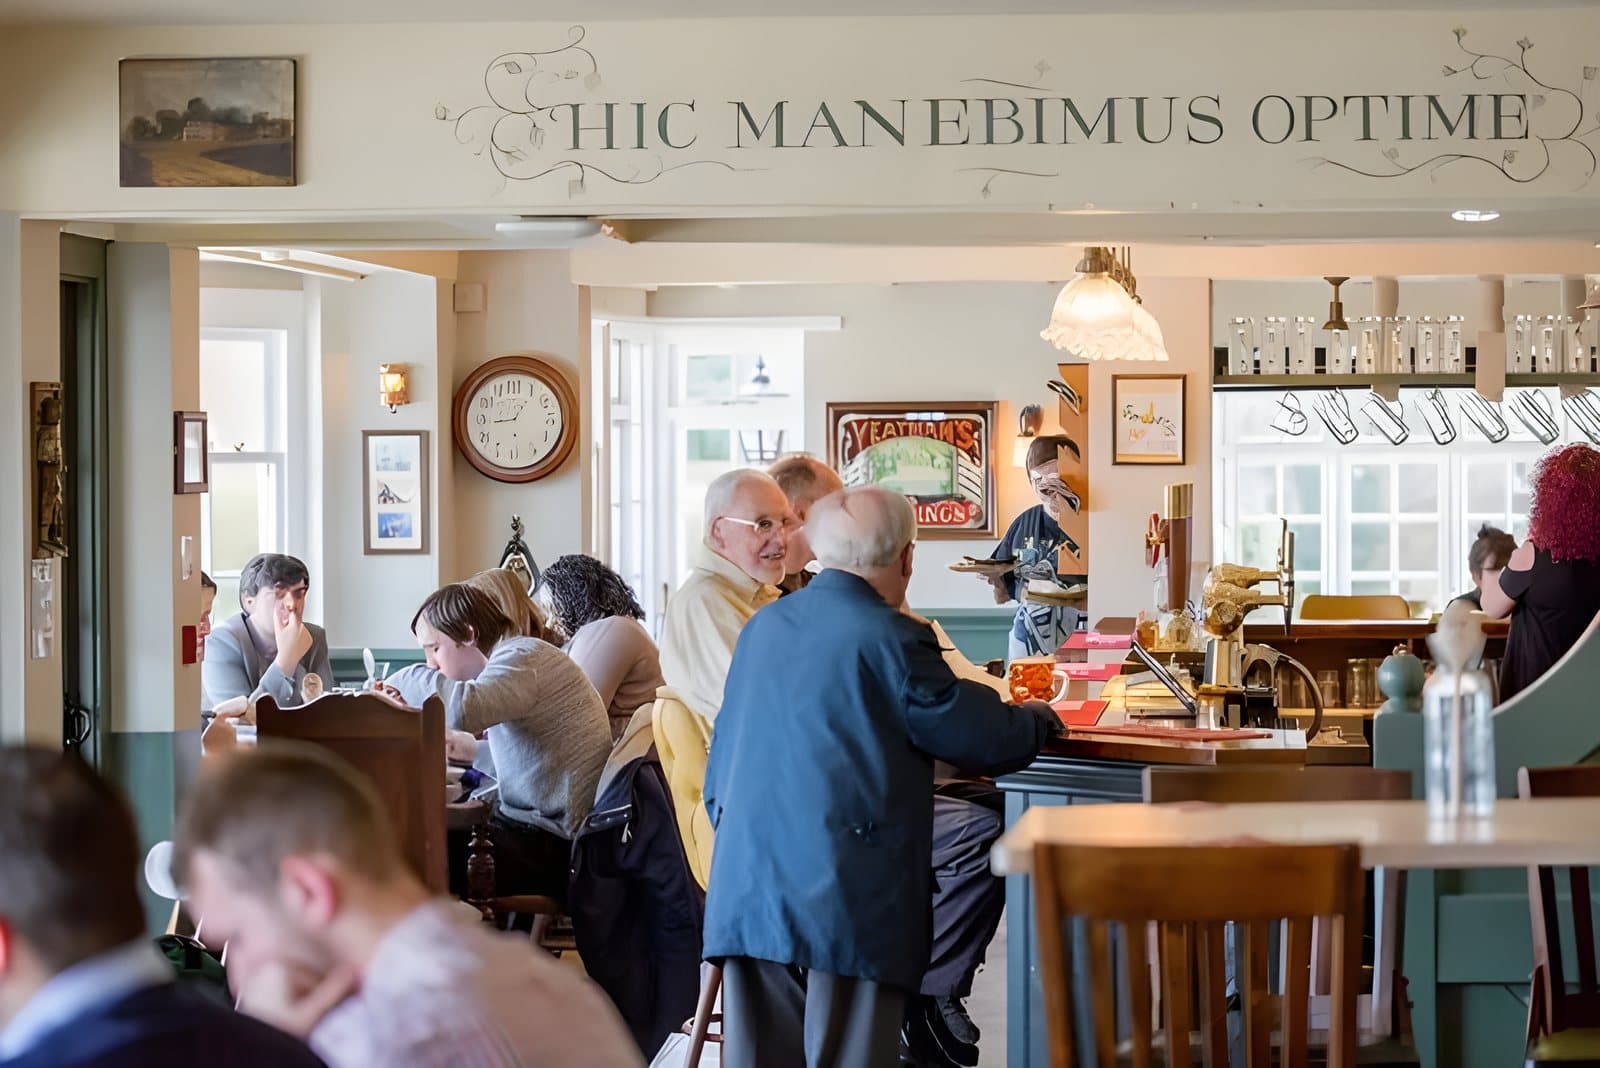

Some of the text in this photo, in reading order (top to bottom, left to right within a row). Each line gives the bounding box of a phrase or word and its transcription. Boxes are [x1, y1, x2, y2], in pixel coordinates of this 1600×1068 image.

[566, 93, 1530, 151] HIC MANEBIMUS OPTIME
